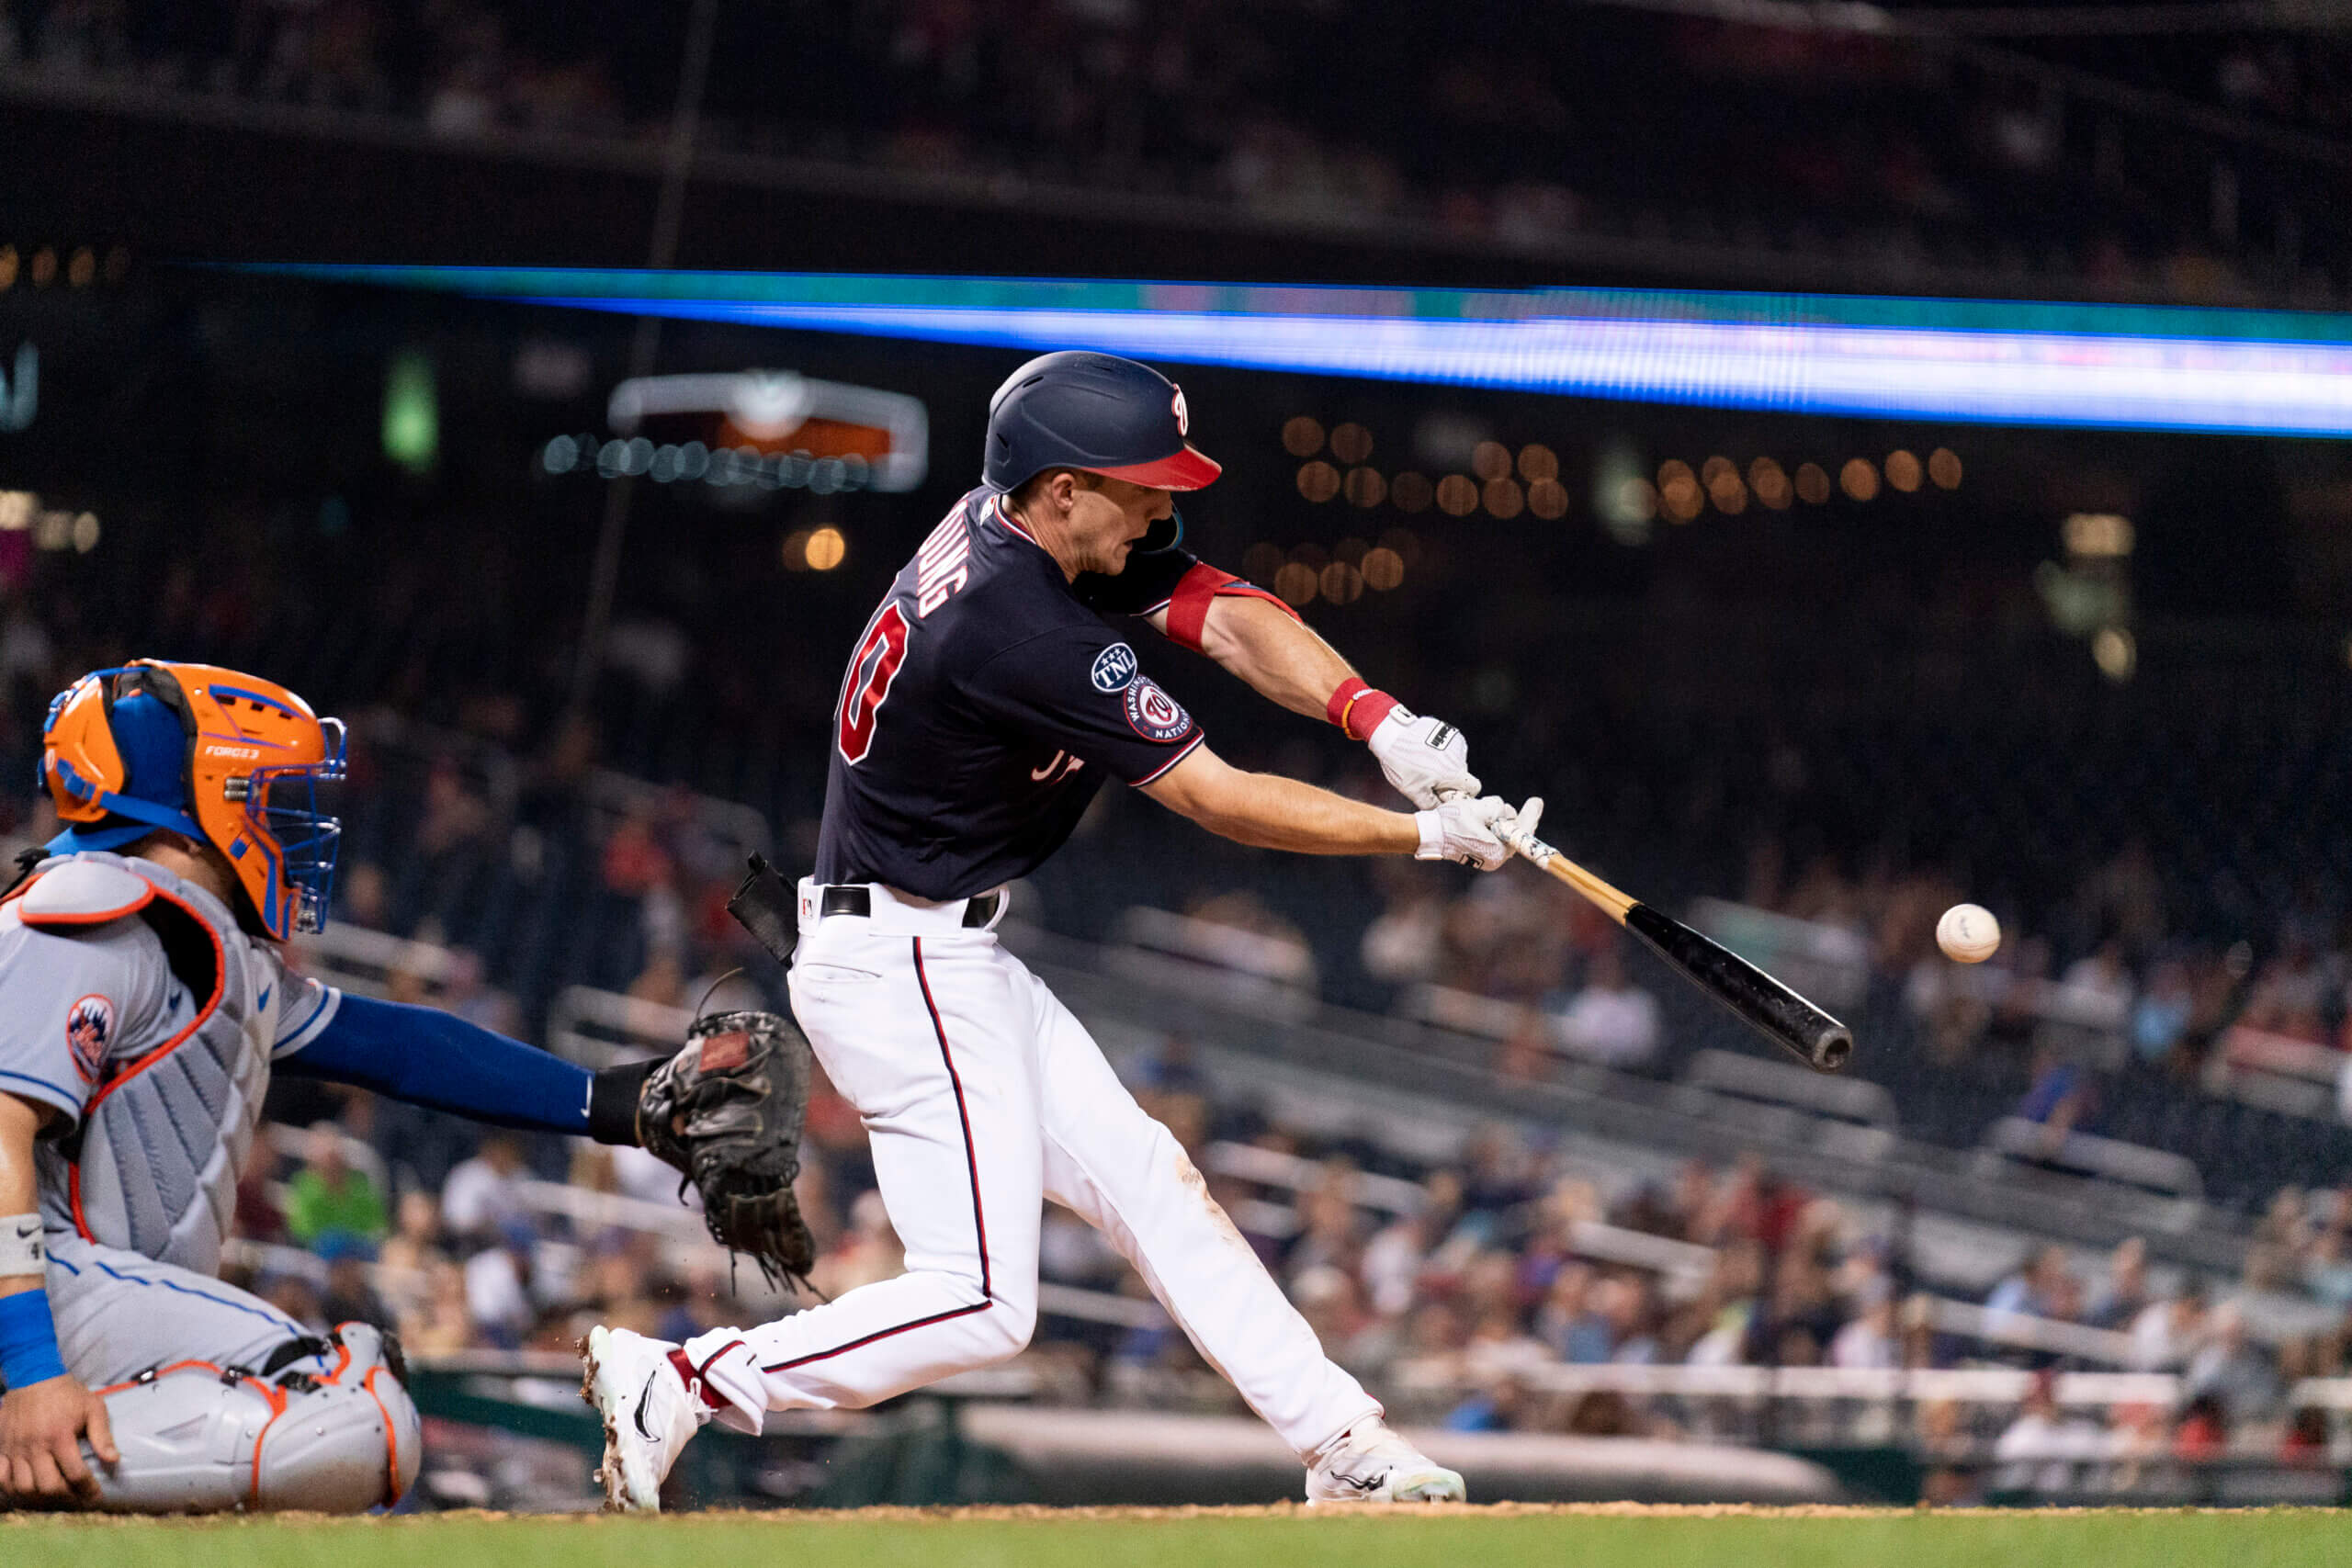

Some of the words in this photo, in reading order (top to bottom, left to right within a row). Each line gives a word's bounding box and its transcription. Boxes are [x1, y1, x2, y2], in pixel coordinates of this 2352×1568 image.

[919, 492, 970, 618] OUNG
[835, 573, 910, 765] 0
[1094, 650, 1136, 688] TNL
[1155, 708, 1191, 739] NATION
